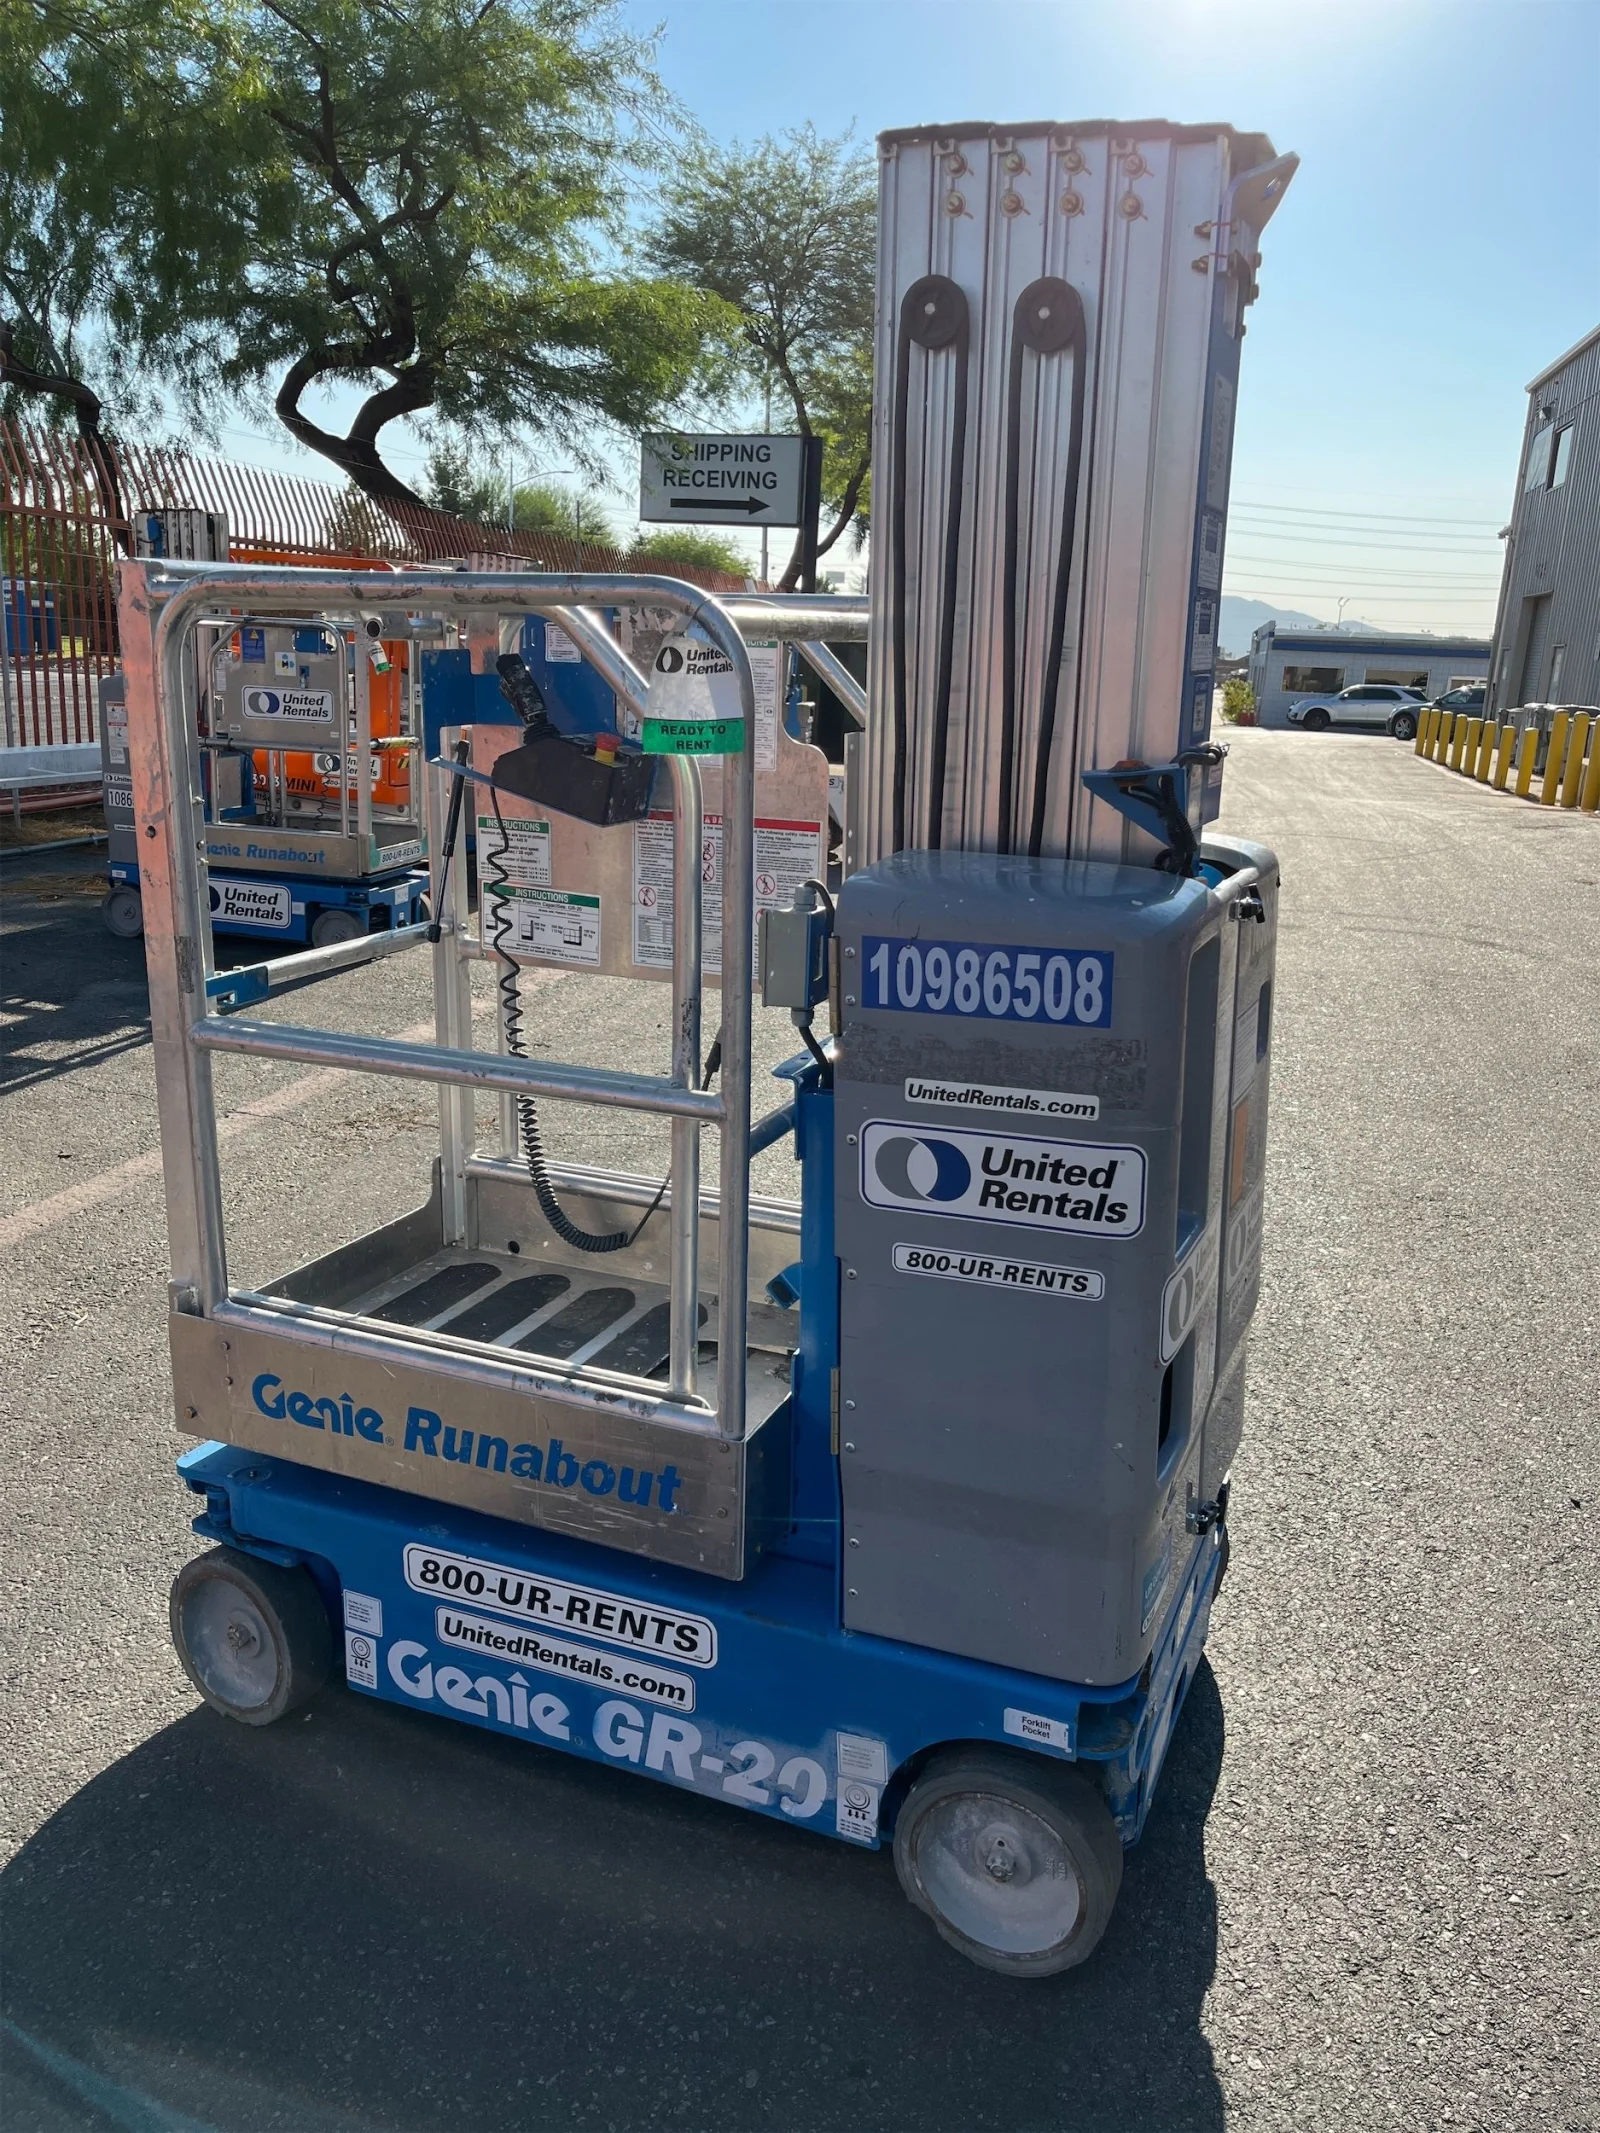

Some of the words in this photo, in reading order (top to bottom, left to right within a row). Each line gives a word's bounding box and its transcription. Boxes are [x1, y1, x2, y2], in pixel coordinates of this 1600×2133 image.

[671, 443, 771, 463] SHIPPING
[663, 469, 777, 489] RECEIVING
[686, 660, 734, 675] Rentals
[282, 693, 325, 706] United
[282, 704, 329, 718] Rentals
[661, 725, 705, 735] READY
[710, 725, 726, 735] TO
[676, 740, 712, 750] RENT
[286, 777, 316, 793] MINI
[109, 790, 133, 806] 1086
[487, 818, 540, 831] INSRUCTIONS
[381, 845, 422, 863] 800-UR-RENTS
[224, 887, 280, 905] United
[515, 888, 569, 902] INSTRUCTIONS
[224, 902, 283, 921] Rentals
[869, 943, 1104, 1023] 10986508
[907, 1083, 1096, 1118] UnitedRentals.com
[980, 1146, 1119, 1189] United
[978, 1179, 1129, 1224] Rentals
[906, 1252, 1089, 1293] 800-UR-RENTS
[251, 1373, 384, 1444] Genie
[403, 1406, 681, 1513] Runabout
[419, 1559, 700, 1652] 800-UR-RENTS
[443, 1616, 686, 1702] UnitedRentals.com
[387, 1639, 571, 1741] Genie
[592, 1699, 828, 1818] GR-20
[1021, 1716, 1051, 1731] Forklift
[1022, 1725, 1051, 1739] Pocket
